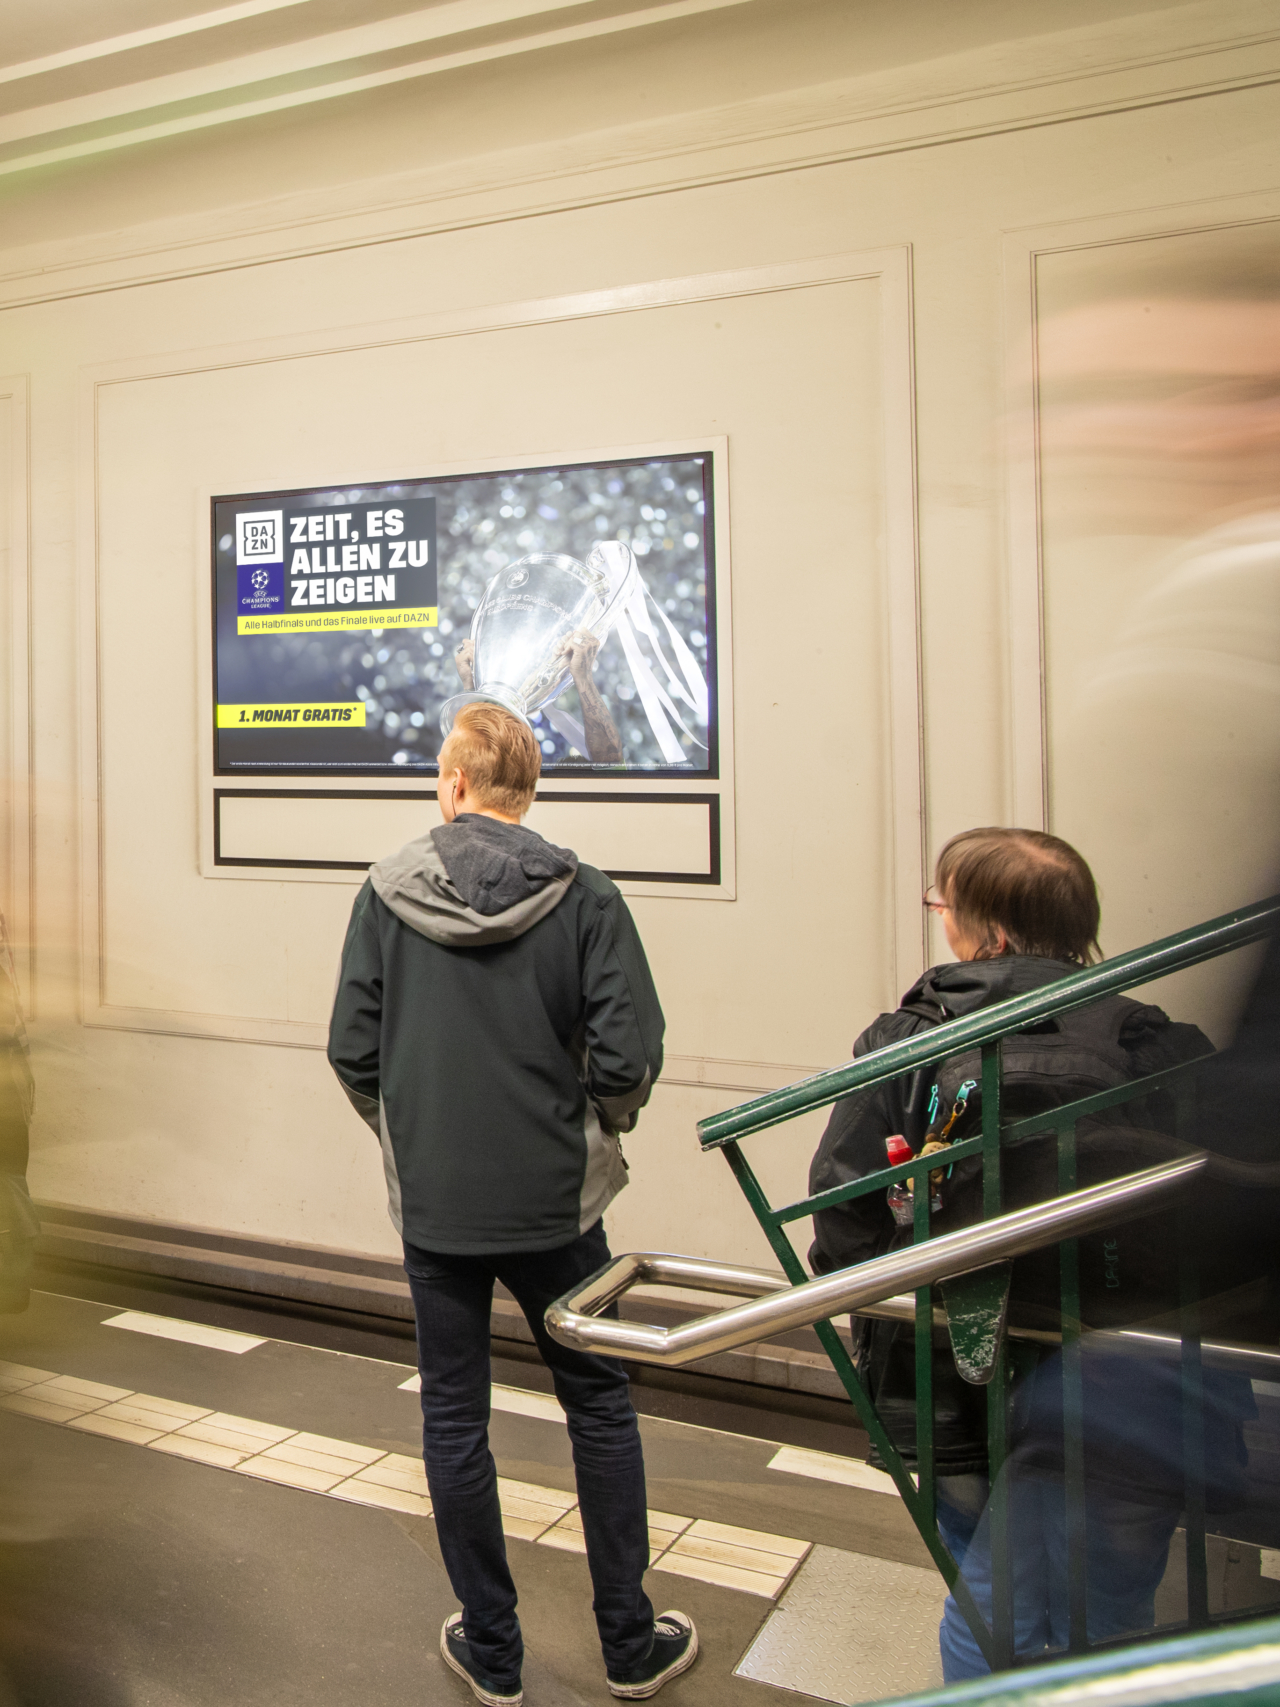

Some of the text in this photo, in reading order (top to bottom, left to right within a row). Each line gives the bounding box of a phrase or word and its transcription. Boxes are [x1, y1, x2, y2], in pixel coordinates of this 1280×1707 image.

[289, 508, 404, 543] ZEIT, ES
[290, 540, 428, 575] ALLEN ZU
[241, 596, 279, 604] CHAMPIONS
[291, 574, 396, 606] ZEIGEN
[244, 613, 430, 629] Alle Halbfinals und das Finale live auf DAZN
[238, 710, 250, 723] 1.
[252, 709, 300, 723] MONAT
